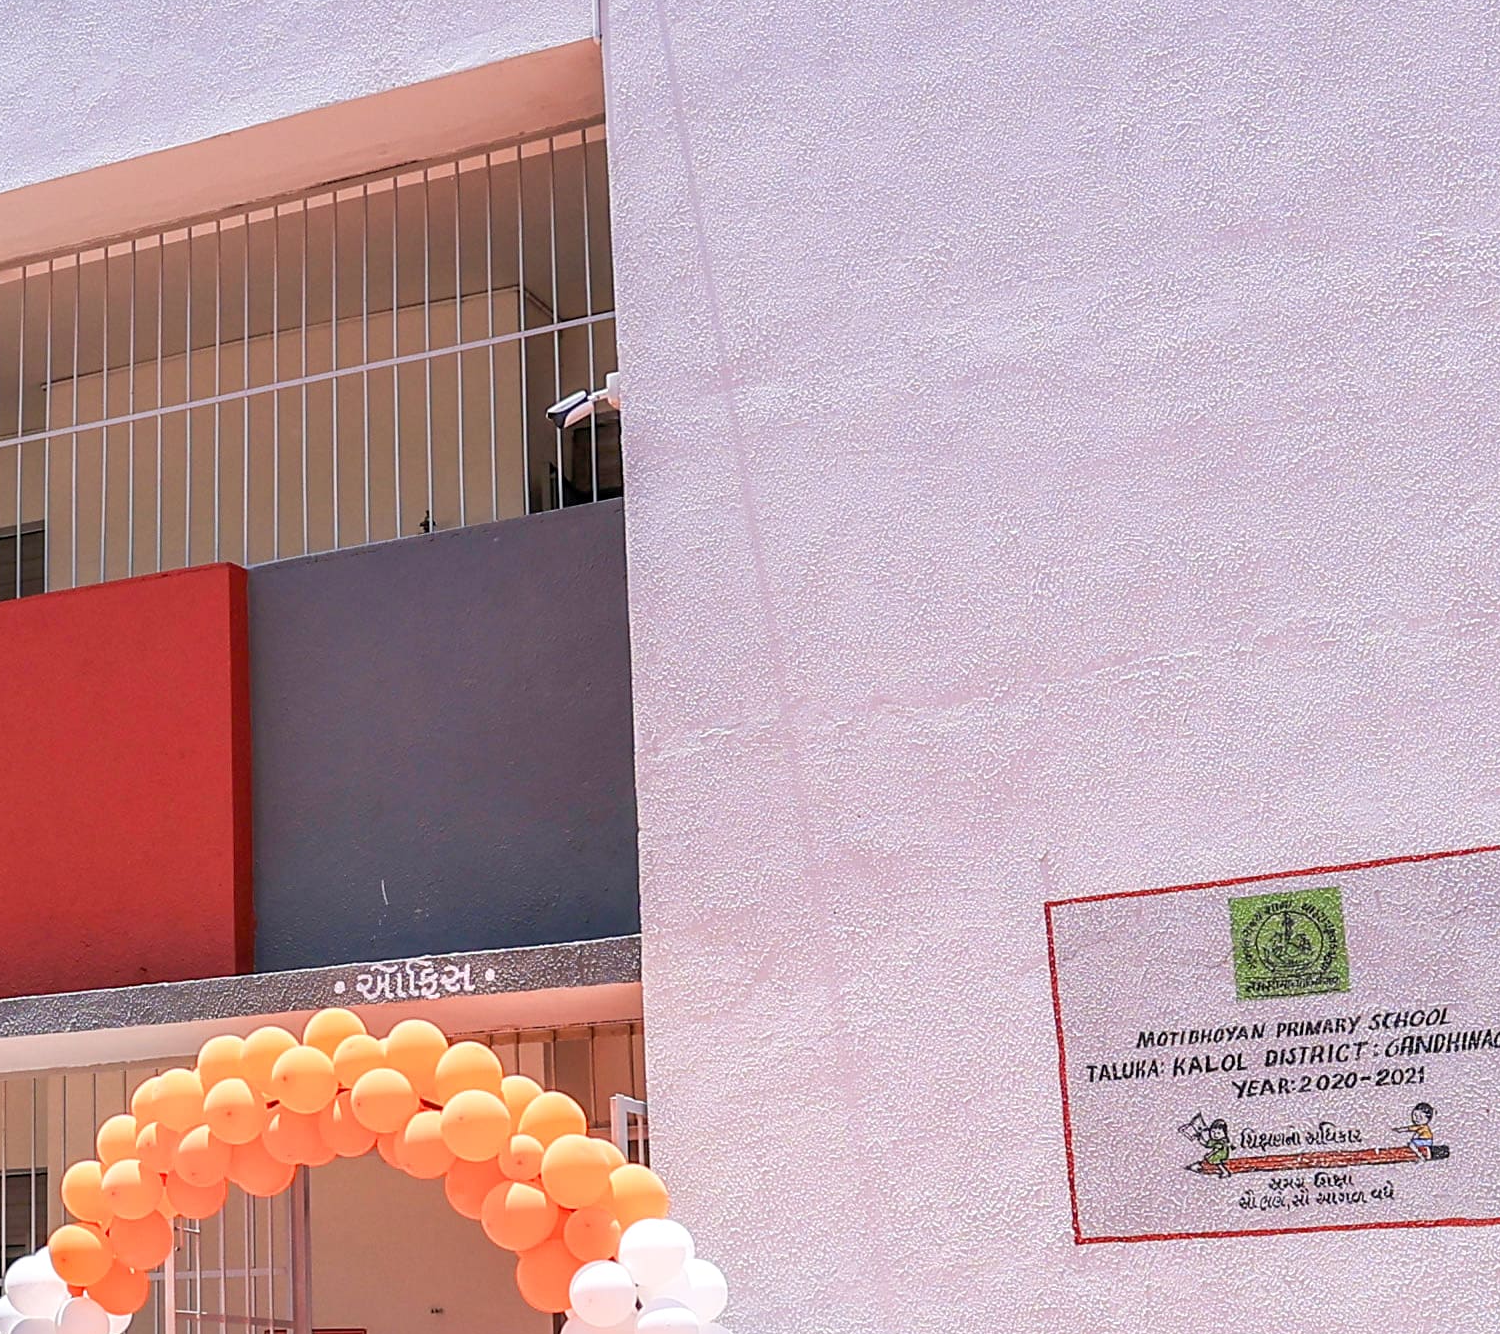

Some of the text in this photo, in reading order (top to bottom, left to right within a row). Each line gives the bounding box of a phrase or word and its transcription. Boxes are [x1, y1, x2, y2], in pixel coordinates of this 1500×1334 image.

[1136, 1008, 1451, 1049] MOTIBHOYAN PRIMARY SCHOOL
[1086, 1060, 1165, 1083] TALUKA:
[1172, 1053, 1248, 1078] KALOL
[1305, 1122, 1363, 1146] અધિકાર
